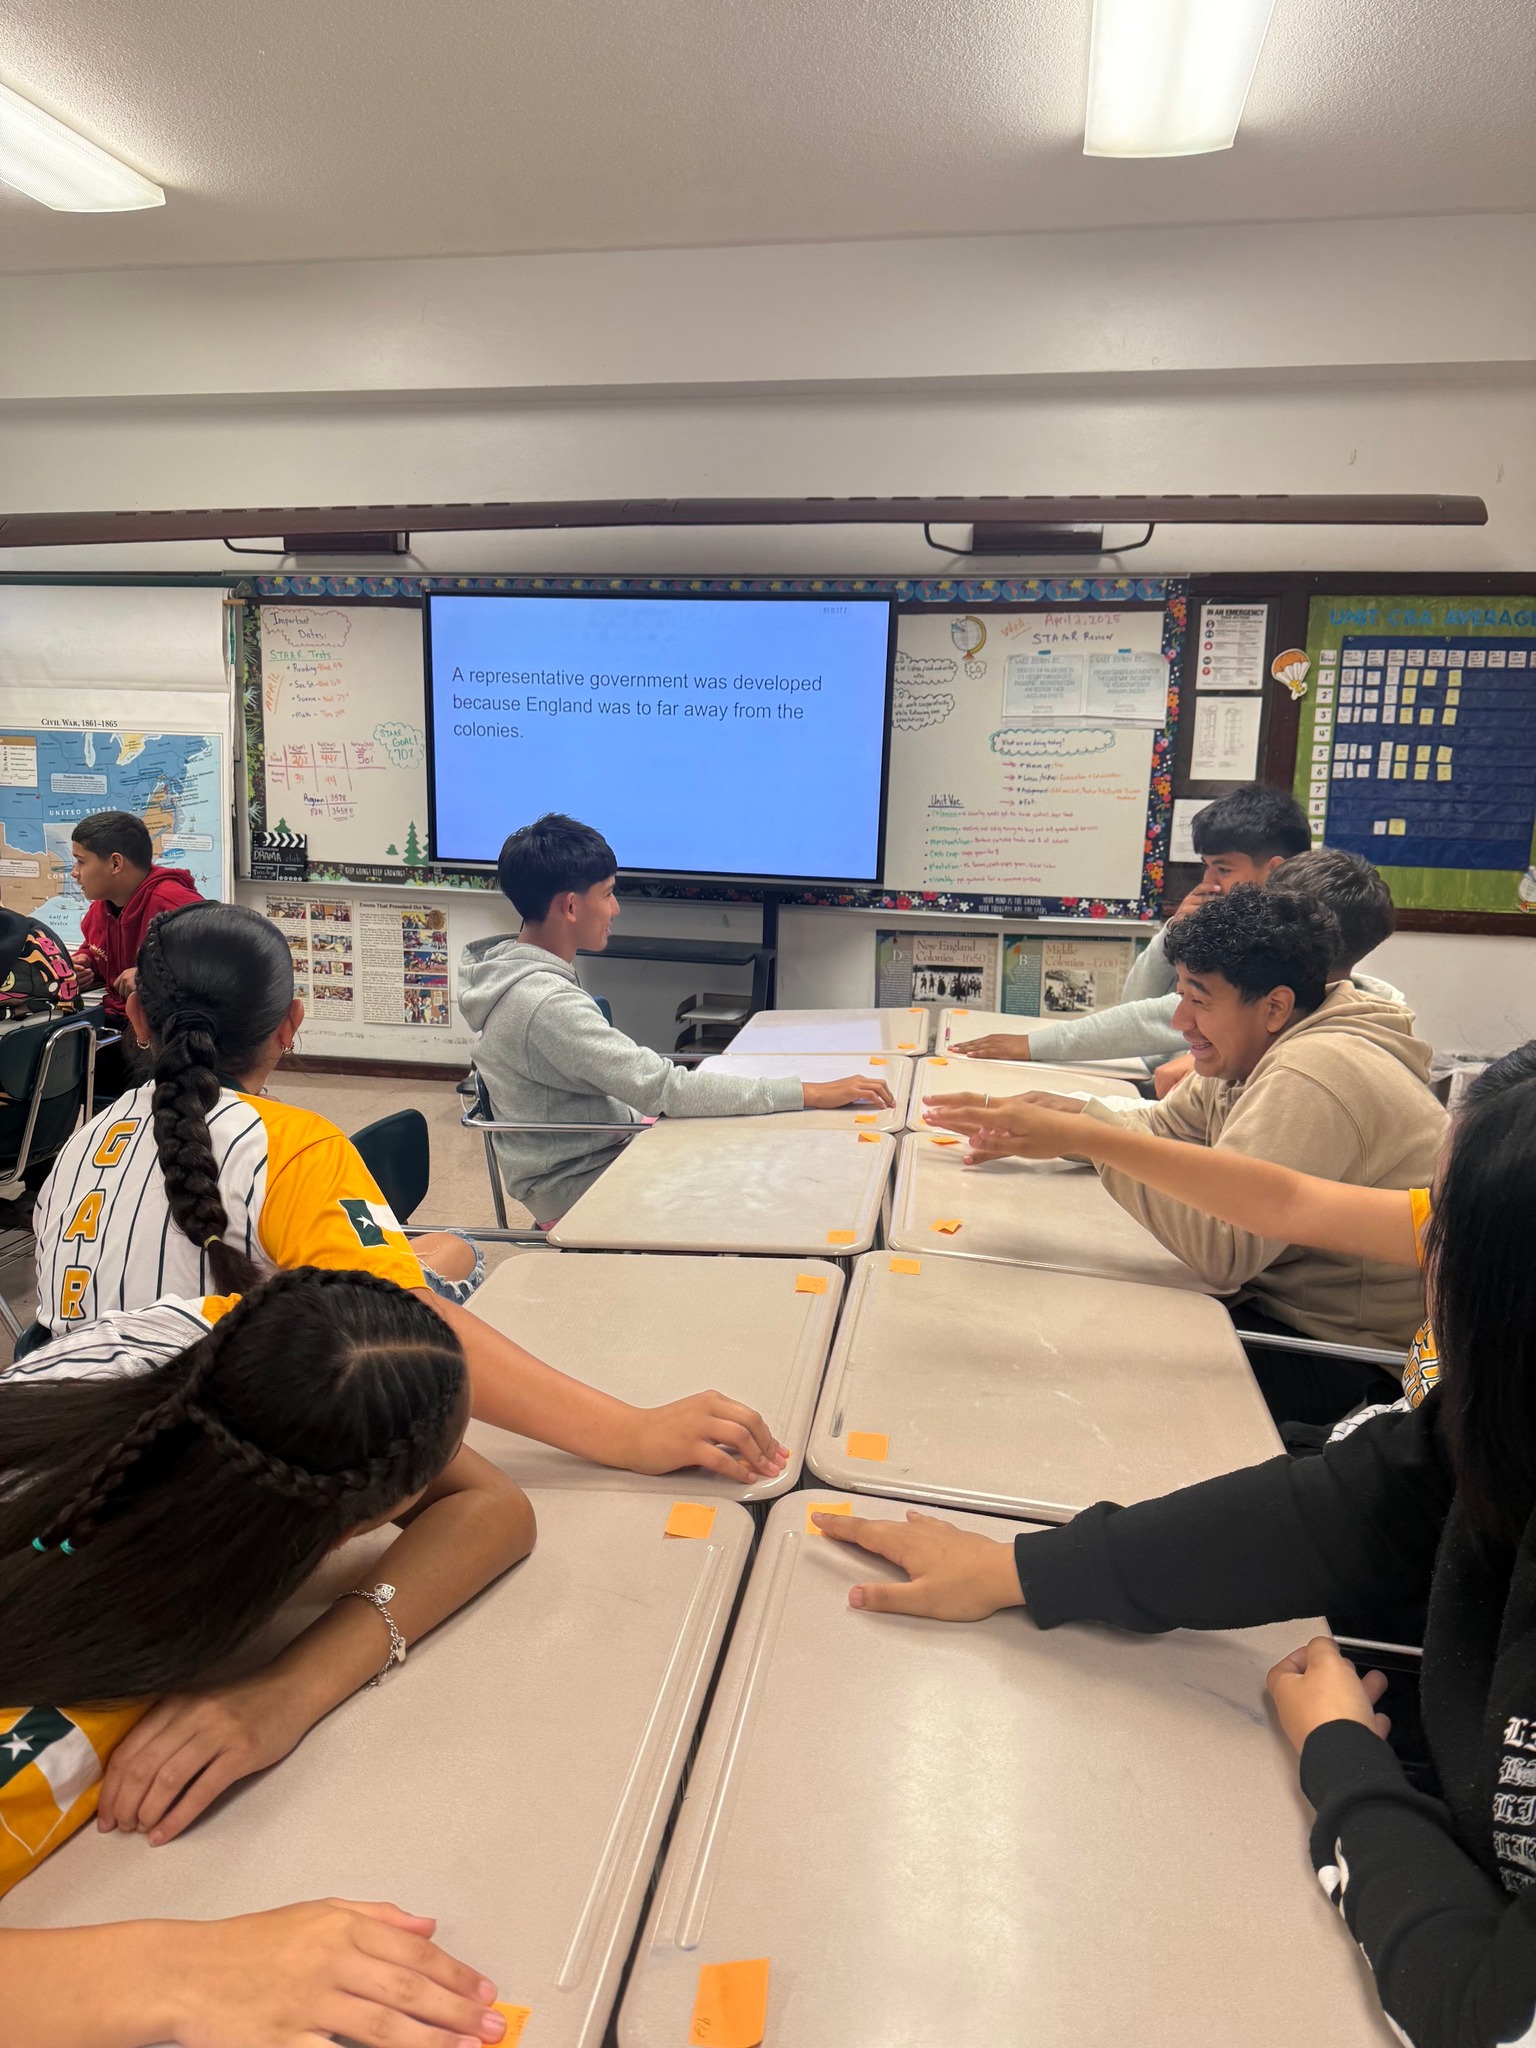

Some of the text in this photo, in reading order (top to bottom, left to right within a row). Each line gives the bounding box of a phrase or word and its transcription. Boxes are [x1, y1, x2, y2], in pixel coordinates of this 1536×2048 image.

[1045, 614, 1071, 626] April
[1330, 609, 1380, 626] UNIT
[1388, 609, 1431, 626] CBA
[298, 629, 327, 640] Dates:
[1032, 631, 1113, 644] STAAR Review
[270, 650, 332, 660] STAAR Tests
[452, 667, 821, 694] A representative government was developed
[453, 694, 803, 721] because England was to far away from the
[41, 718, 61, 726] CIVIL
[454, 722, 523, 738] colonies.
[931, 794, 947, 806] Unit
[86, 806, 117, 814] STATES
[254, 850, 282, 862] DRAMA
[917, 939, 976, 953] New England
[1045, 943, 1078, 955] Middle
[916, 951, 954, 963] Colonies
[1045, 956, 1084, 967] Colonies
